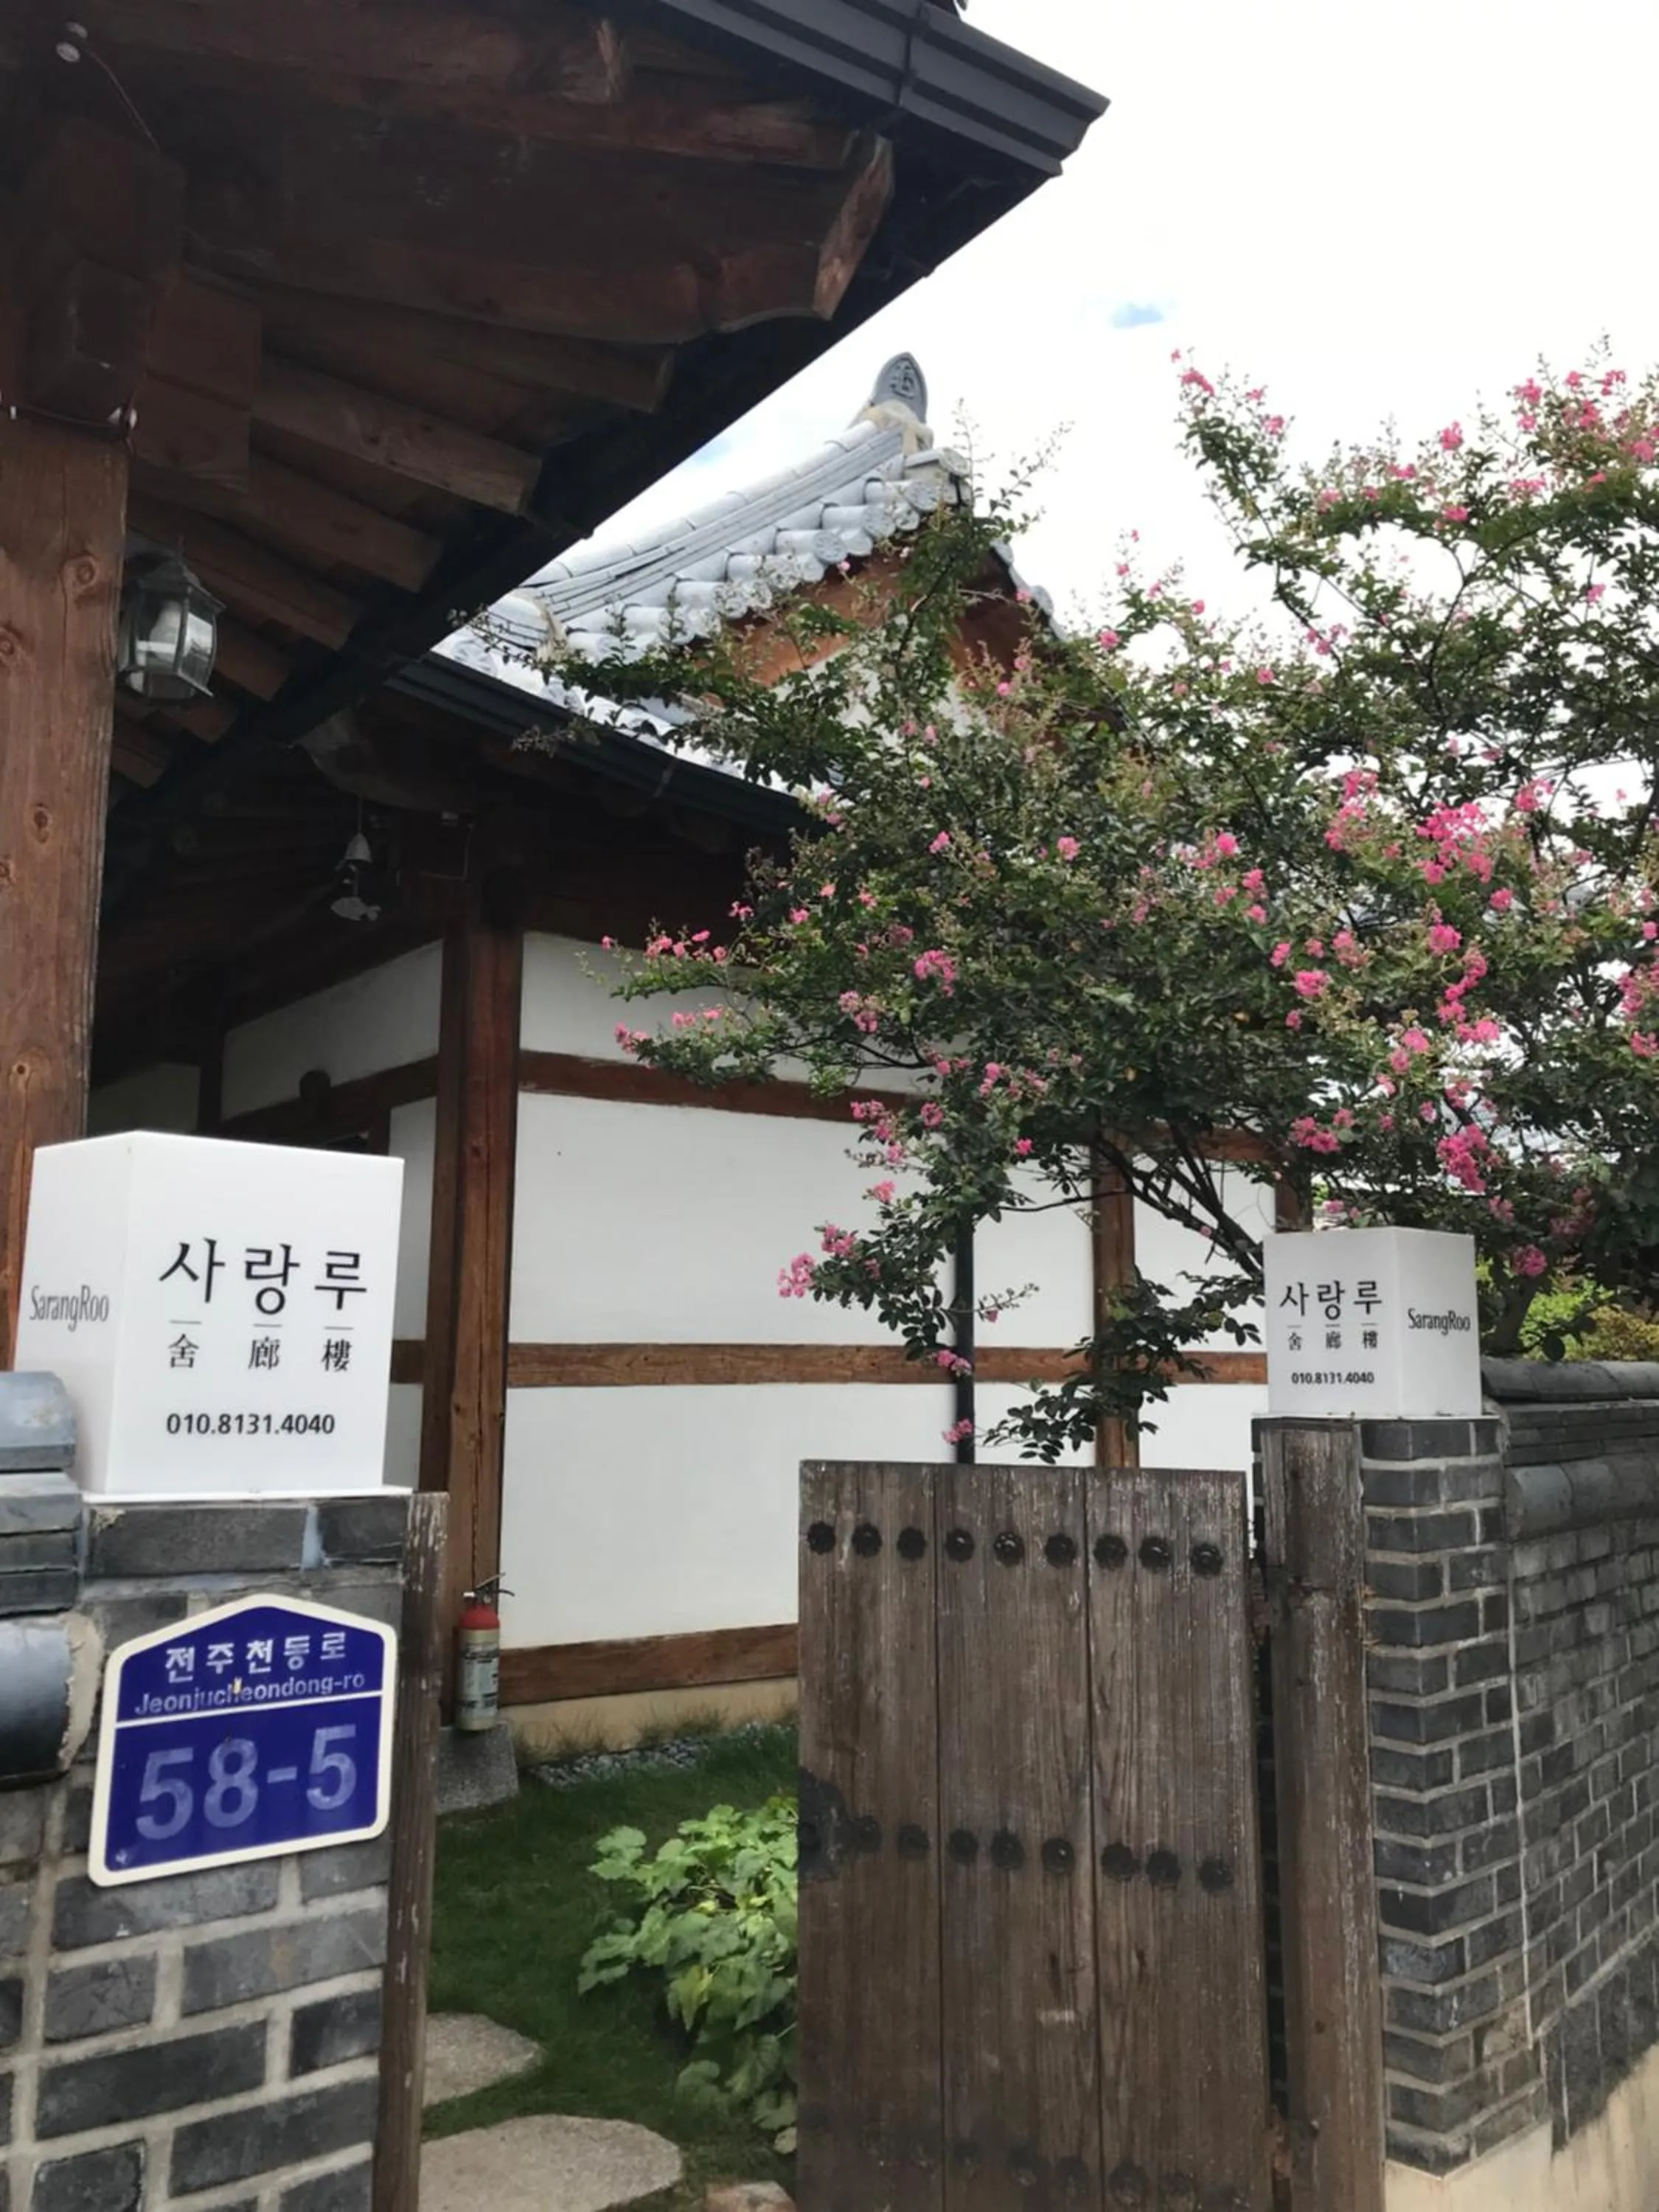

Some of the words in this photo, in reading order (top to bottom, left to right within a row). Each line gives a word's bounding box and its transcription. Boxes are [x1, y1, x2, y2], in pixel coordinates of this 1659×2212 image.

[158, 1237, 368, 1316] 사랑루
[29, 1284, 110, 1332] SarangRoo
[1279, 1279, 1382, 1321] 사랑루
[1407, 1307, 1472, 1335] SarangRoo
[1291, 1371, 1375, 1385] 010.8131.4040
[166, 1412, 336, 1436] 010.8131.4040
[134, 1724, 358, 1840] 58-5
